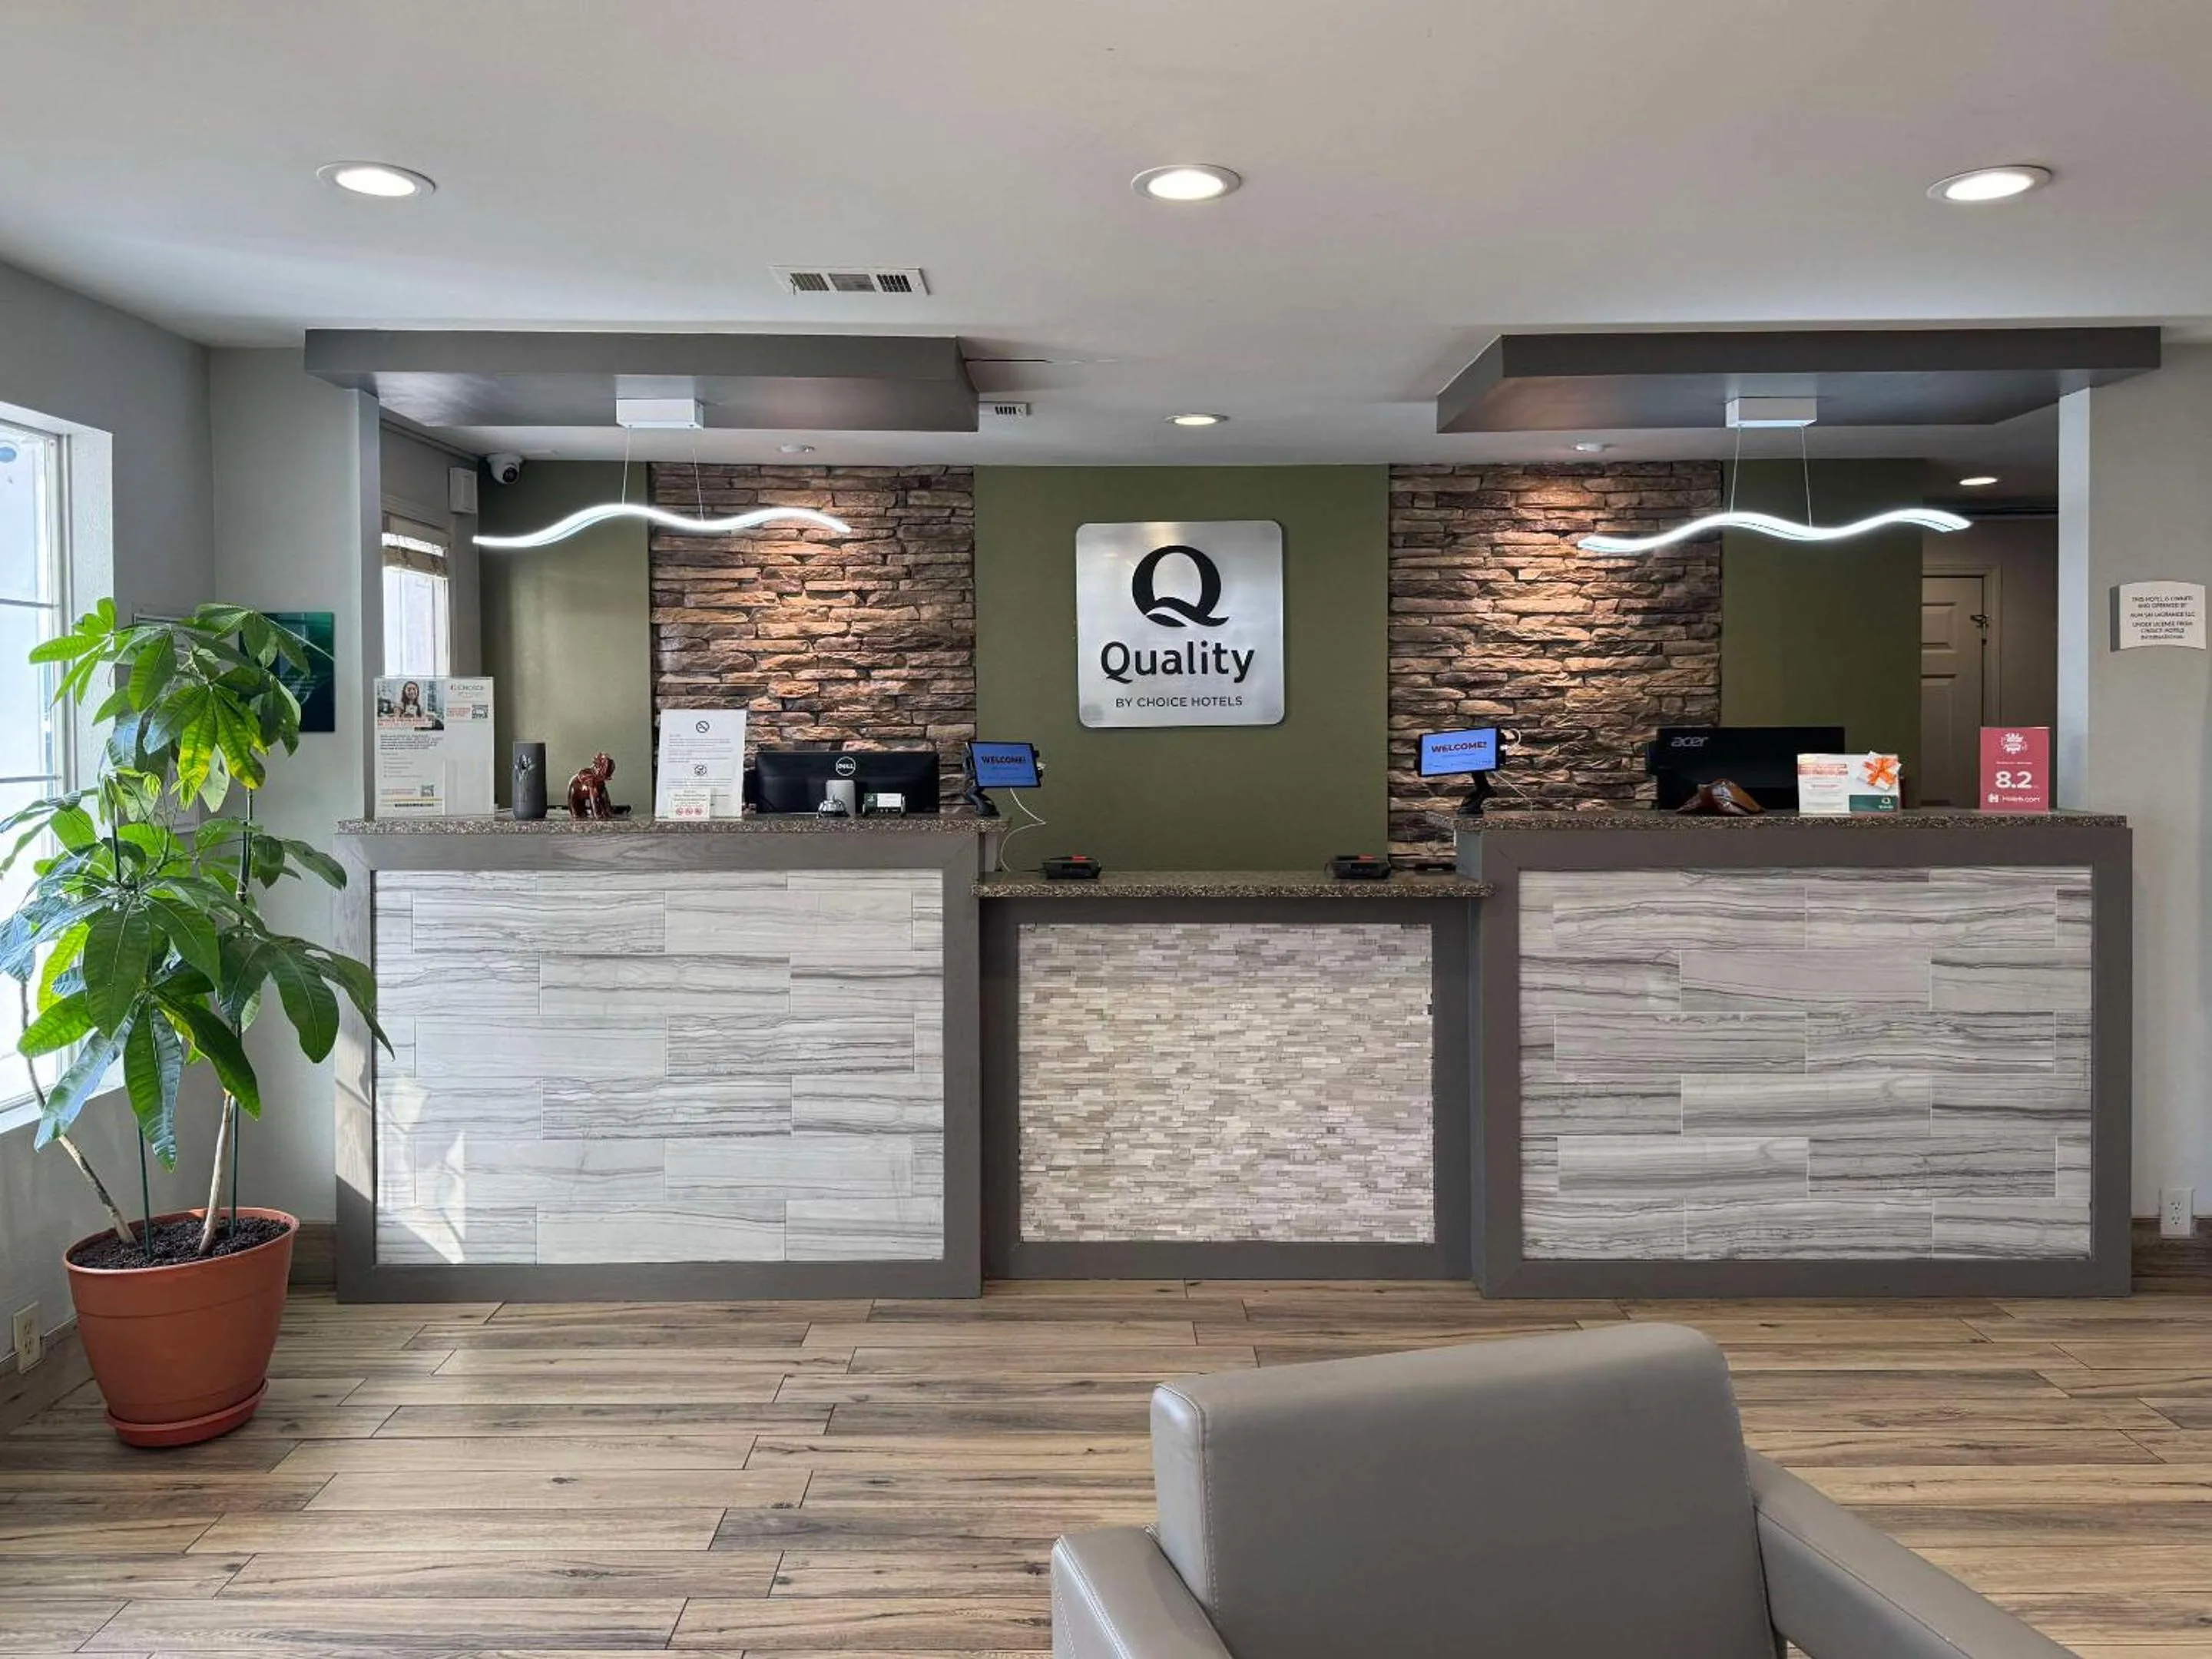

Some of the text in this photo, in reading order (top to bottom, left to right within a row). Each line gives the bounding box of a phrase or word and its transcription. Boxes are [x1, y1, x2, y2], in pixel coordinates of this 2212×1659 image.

[1132, 545, 1229, 628] Q
[1101, 641, 1256, 684] Quality
[1115, 695, 1243, 708] BY CHOICE HOTELS
[1431, 741, 1487, 753] WELCOME!
[1671, 737, 1709, 747] acer
[981, 755, 1027, 764] WELCOME!
[1995, 770, 2032, 789] 8.2
